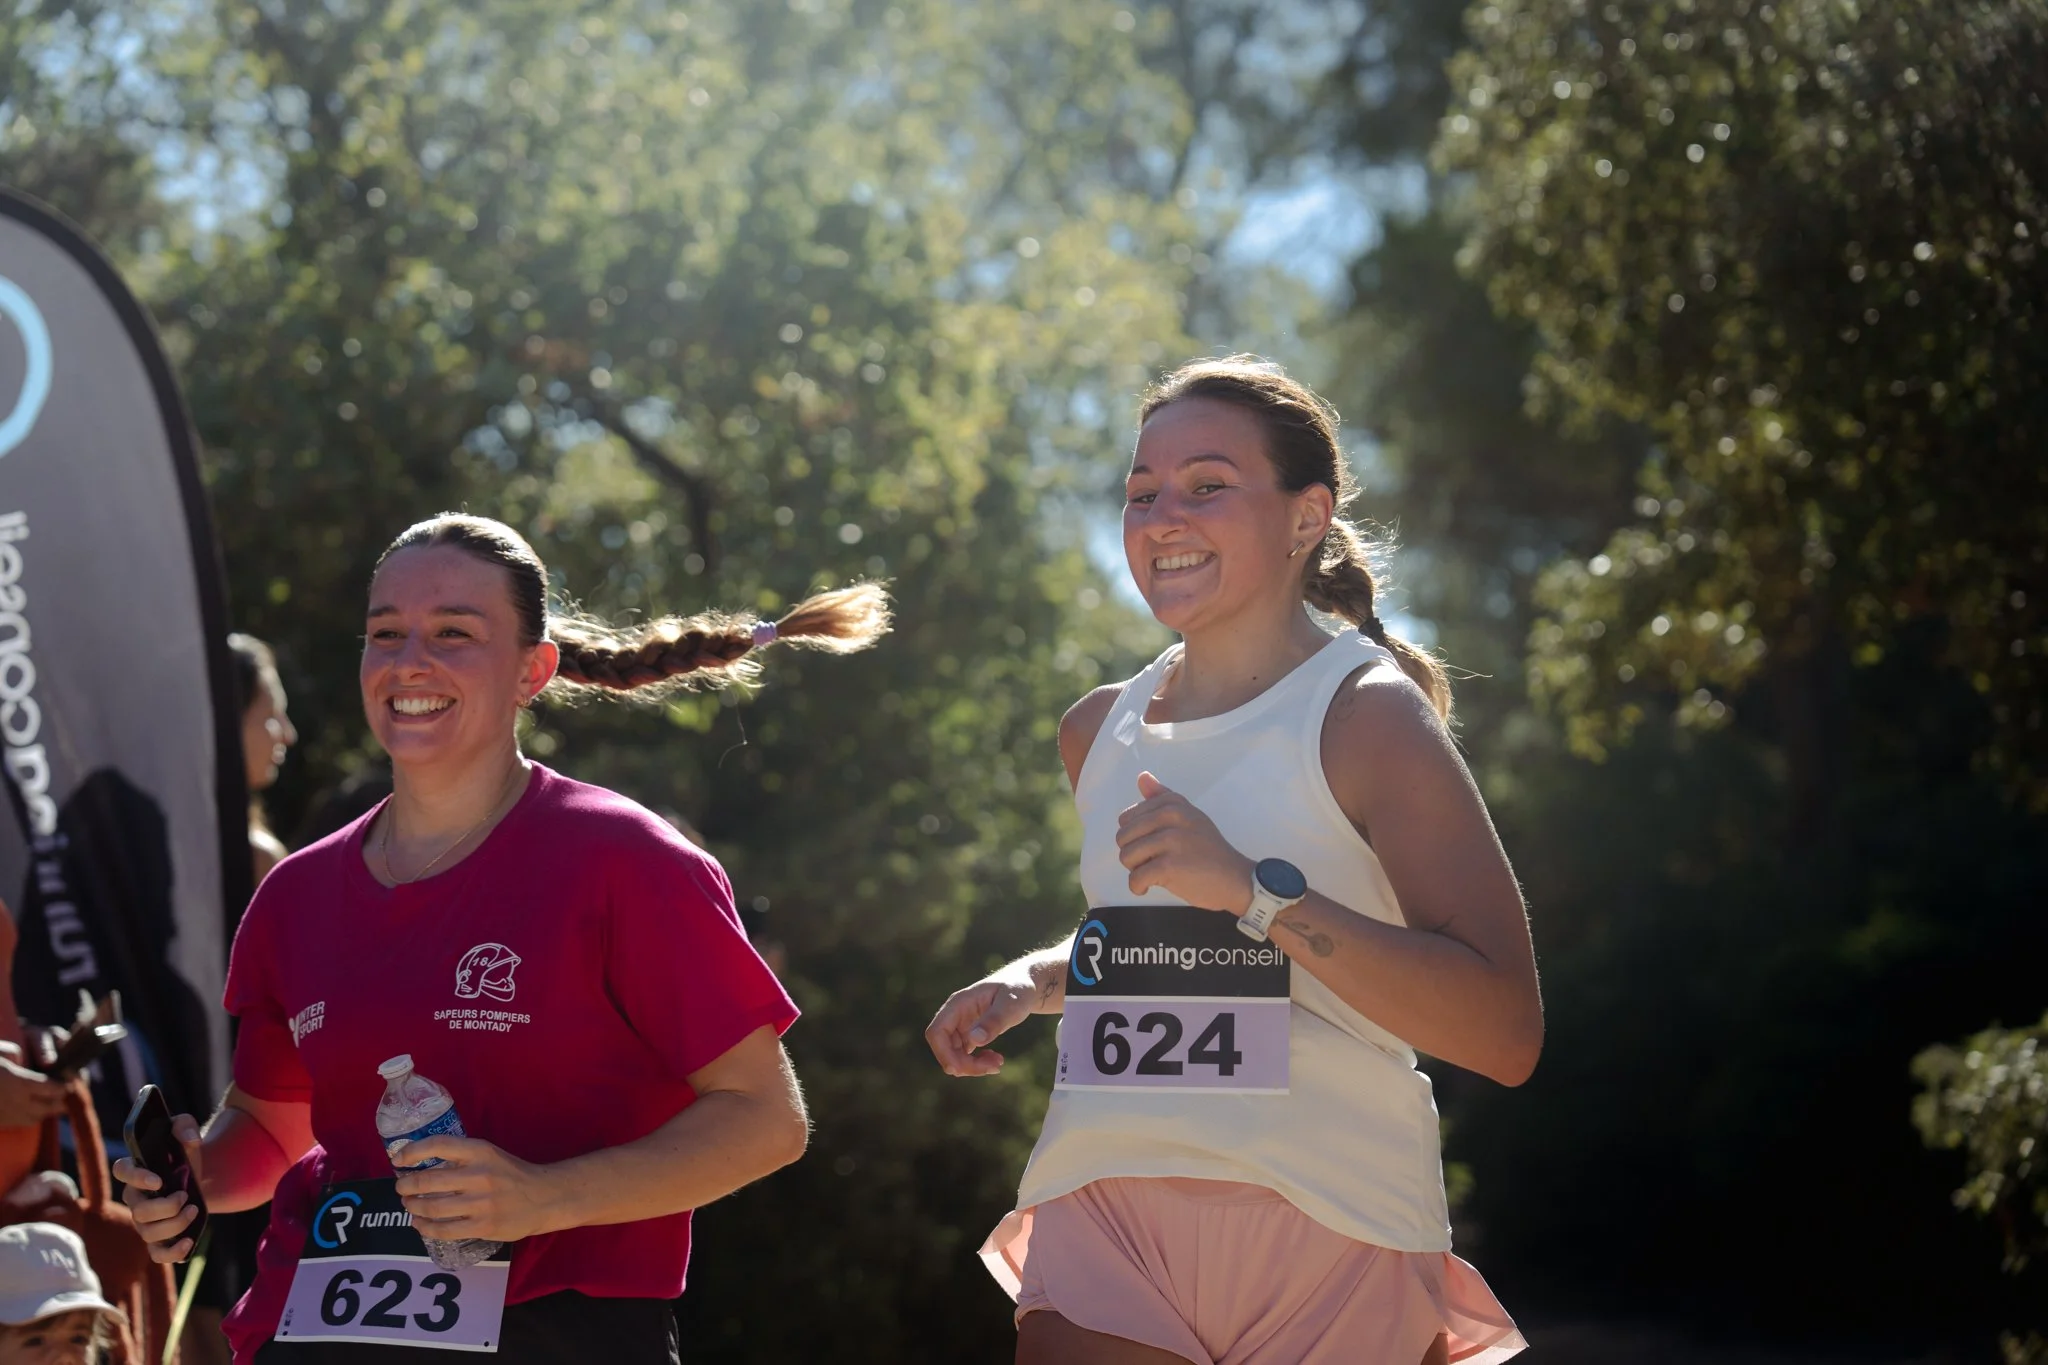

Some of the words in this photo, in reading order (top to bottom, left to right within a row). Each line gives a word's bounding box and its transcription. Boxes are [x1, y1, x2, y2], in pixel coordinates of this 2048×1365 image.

[472, 957, 489, 967] 18
[1111, 942, 1284, 971] runningconseil
[300, 1014, 325, 1040] SPORT
[433, 1009, 478, 1021] SAPEURS
[480, 1009, 531, 1024] POMPIERS
[449, 1020, 462, 1030] DE
[463, 1020, 512, 1033] MONTADY
[1092, 1011, 1242, 1077] 624
[320, 1268, 462, 1333] 623
